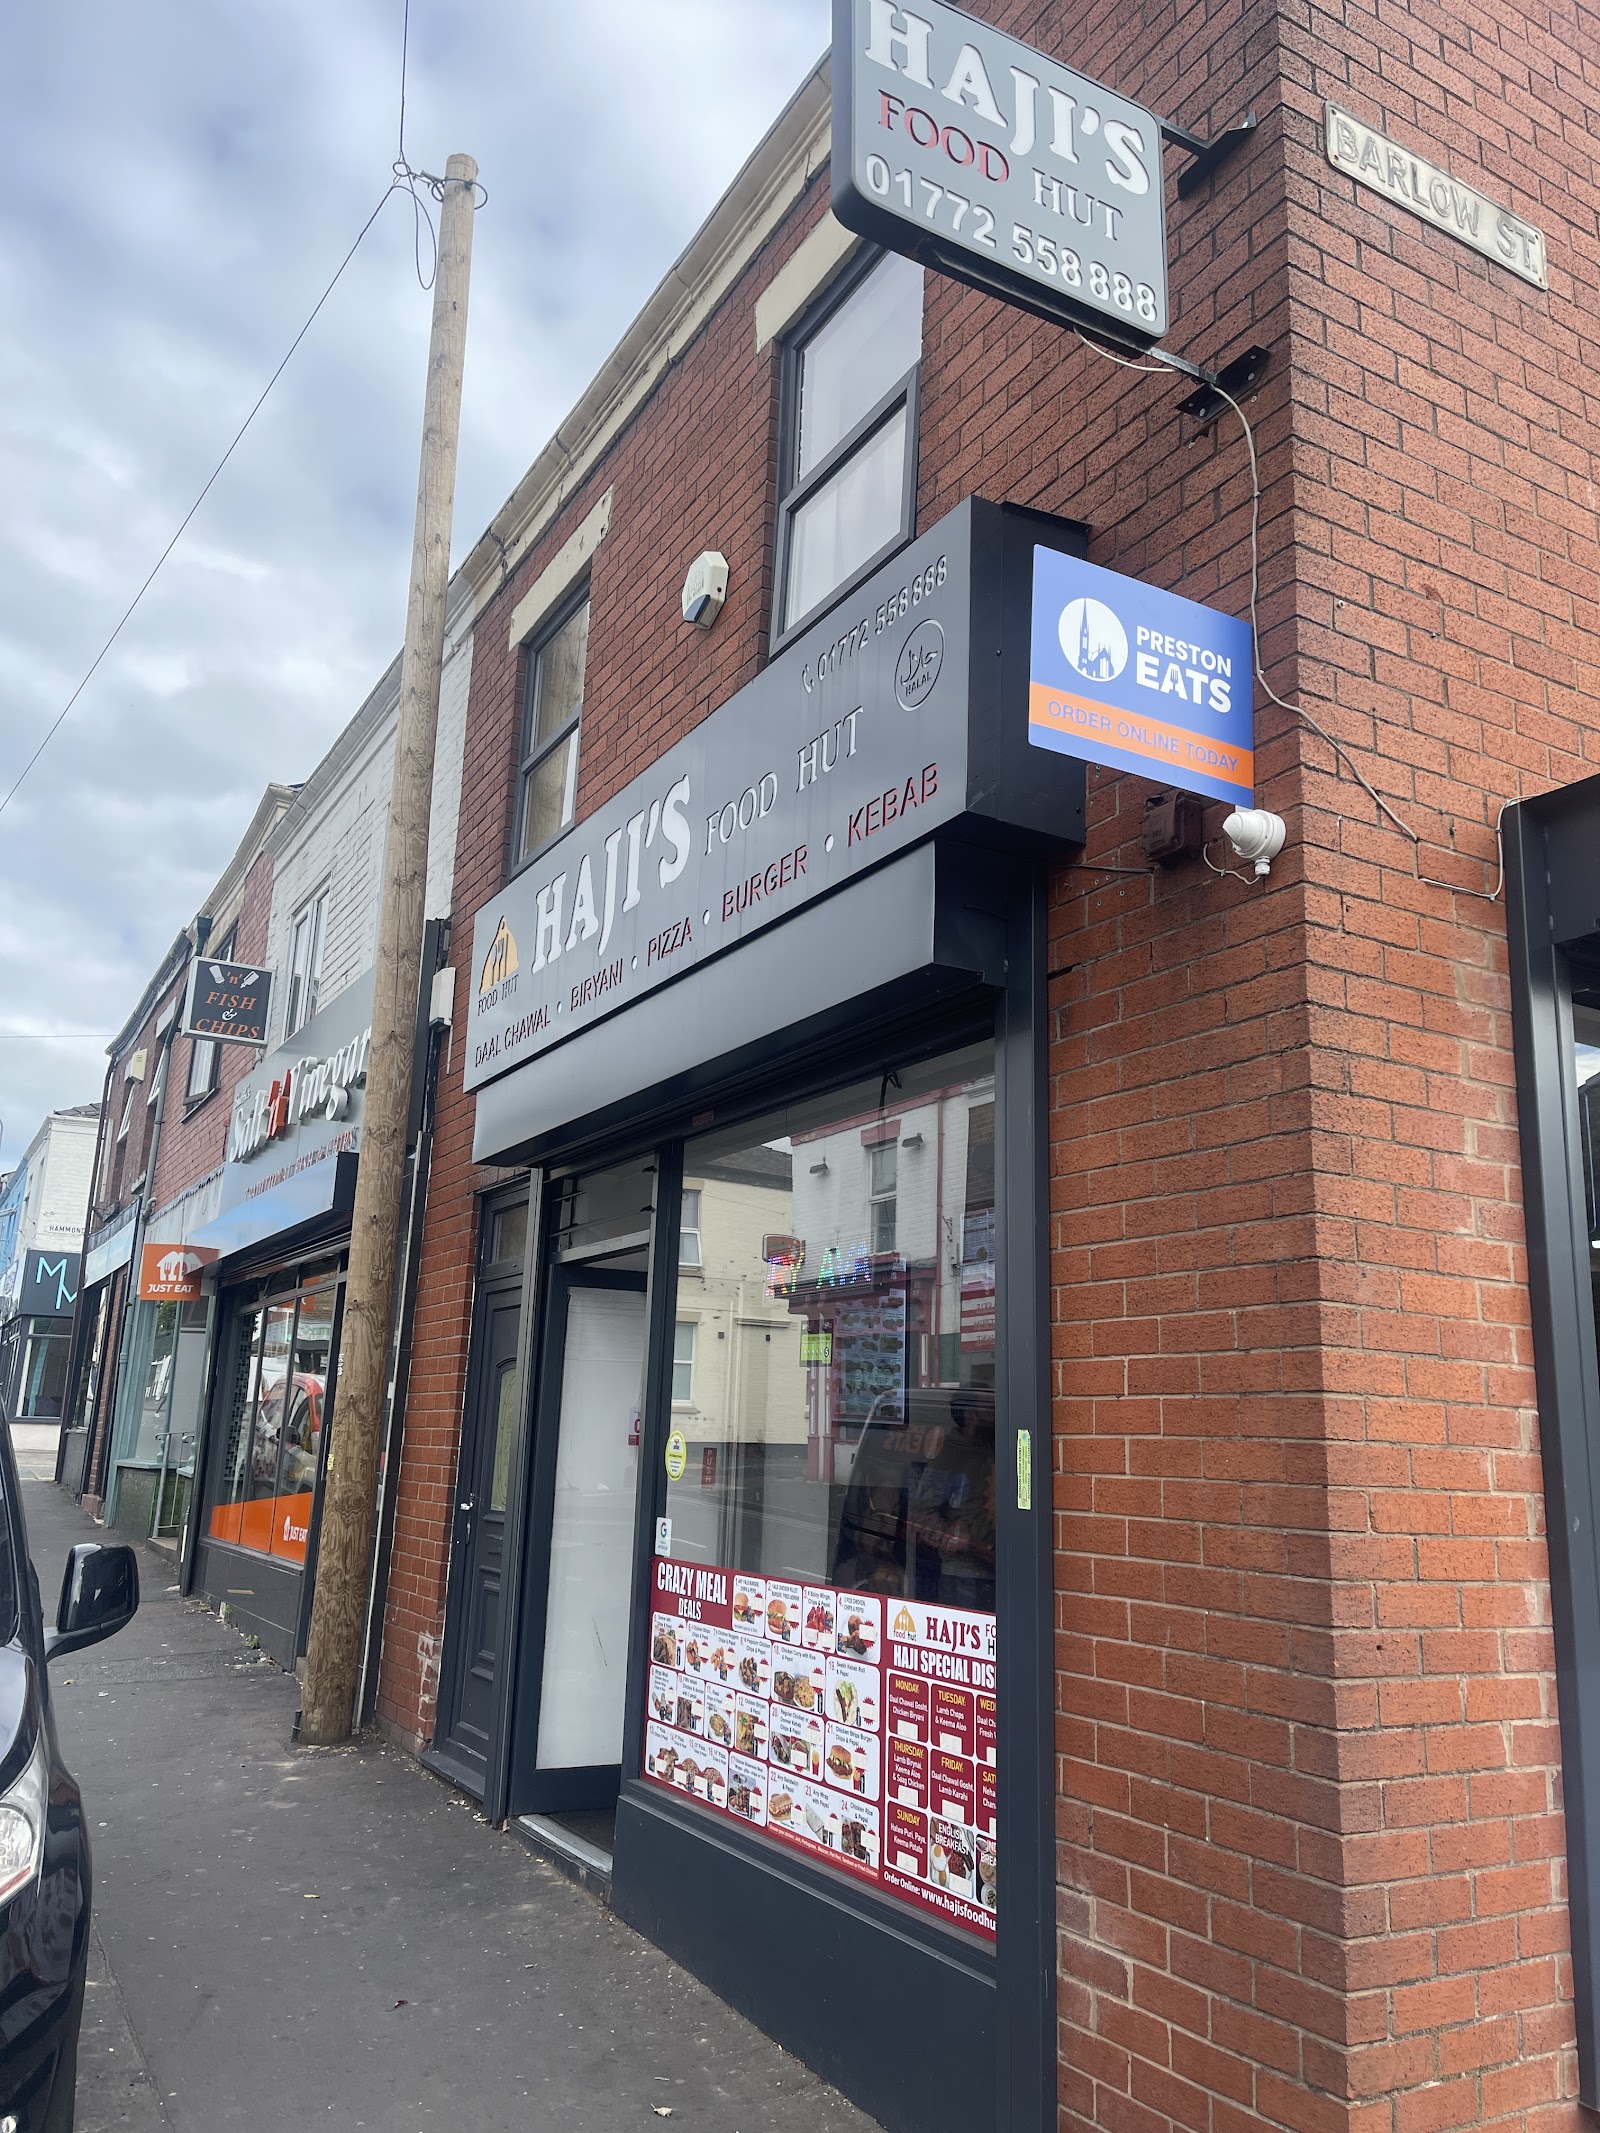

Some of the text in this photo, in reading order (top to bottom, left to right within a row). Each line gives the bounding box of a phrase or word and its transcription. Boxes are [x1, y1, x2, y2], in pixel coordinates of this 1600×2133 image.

[865, 0, 1151, 195] HAJI'S
[878, 89, 1124, 241] FOOD HUT
[866, 153, 997, 249] 01772
[1336, 118, 1538, 273] BARLOW ST.
[817, 618, 869, 681] 01772
[1136, 625, 1232, 677] PRESTON
[906, 671, 932, 697] HALAL
[1136, 651, 1232, 714] EATS
[1048, 700, 1239, 772] ORDER ONLINE TODAY
[532, 705, 864, 974] HAJI'S FOOD HUT
[475, 762, 939, 1068] DAAL CHAWAL BIRYANI PIZZA BURGER KEBAB
[205, 991, 257, 1011] FISH
[477, 974, 519, 1017] FOOD HUT
[222, 1008, 237, 1021] &
[195, 1018, 261, 1040] CHIPS
[147, 1284, 195, 1294] JUST EAT
[289, 1525, 309, 1543] JUST EAT
[657, 1562, 728, 1606] CRAZY MEAL
[678, 1598, 702, 1621] DEALS
[894, 1630, 905, 1639] food
[926, 1616, 981, 1651] HAJI'S
[894, 1644, 918, 1671] HAJI
[921, 1650, 970, 1683] SPECIAL
[893, 1706, 924, 1722] Chicken Biryani
[936, 1705, 964, 1720] Lamb Chops
[977, 1715, 988, 1726] Daal
[940, 1717, 955, 1728] Keema
[955, 1721, 967, 1732] Aloo
[980, 1727, 993, 1738] Fresh
[894, 1754, 906, 1763] Lamb
[896, 1764, 921, 1779] Keema Aloo
[931, 1770, 941, 1780] Daal
[942, 1773, 959, 1785] Chawal
[897, 1775, 907, 1786] Saag
[908, 1778, 925, 1790] Chicken
[939, 1784, 968, 1801] Lamb Karahi
[897, 1809, 920, 1826] SUNDAY
[890, 1823, 904, 1834] Halwa
[938, 1823, 963, 1841] ENGLISH
[894, 1835, 923, 1854] Keema Potato
[935, 1833, 969, 1856] BREAKFAST
[884, 1871, 996, 1931] Order Online: www.hajisfoodhu
